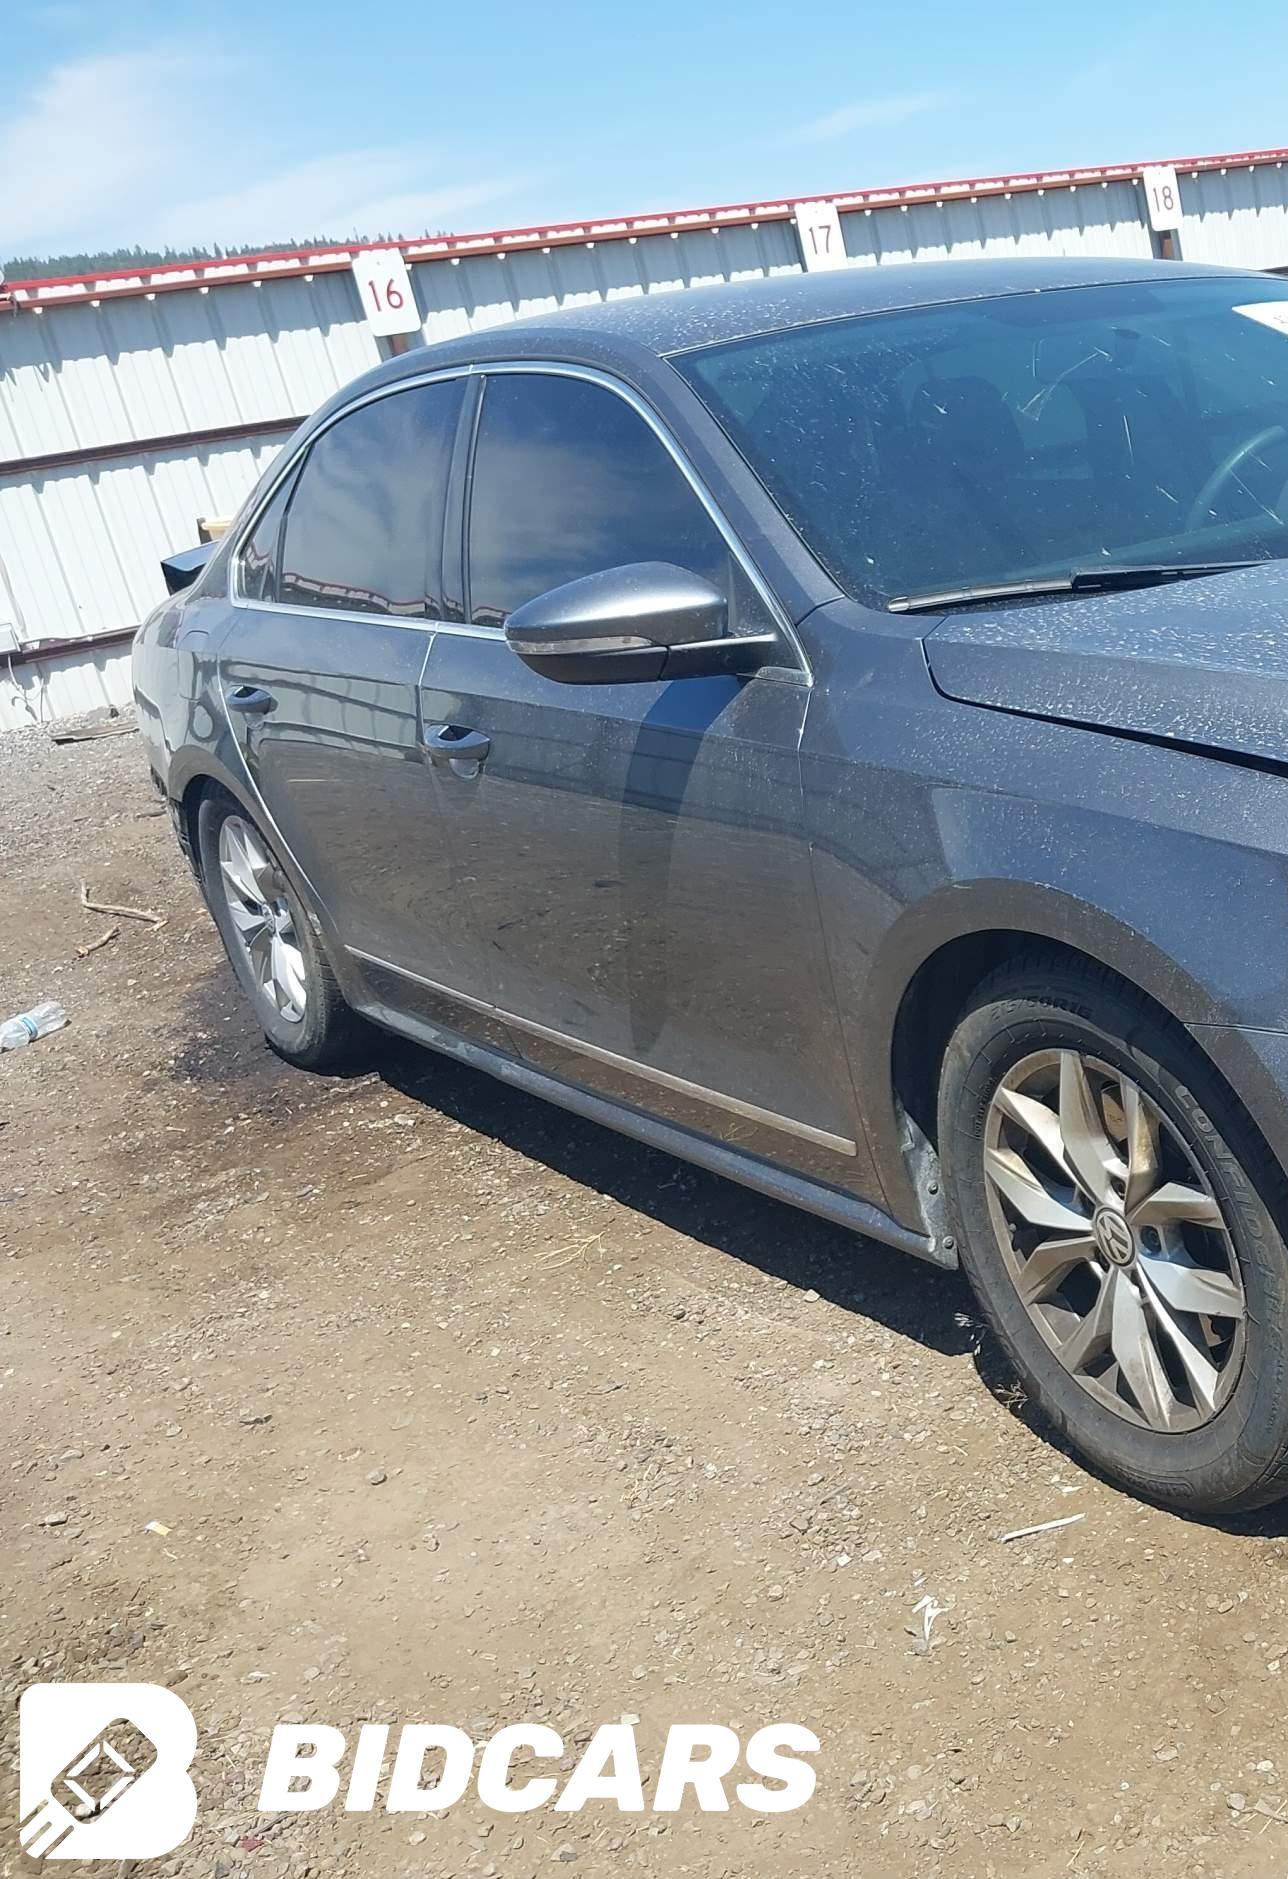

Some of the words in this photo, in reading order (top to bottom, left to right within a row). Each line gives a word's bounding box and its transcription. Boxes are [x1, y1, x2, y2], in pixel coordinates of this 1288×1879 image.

[1153, 185, 1174, 213] 18
[809, 225, 831, 254] 17
[368, 278, 404, 312] 16
